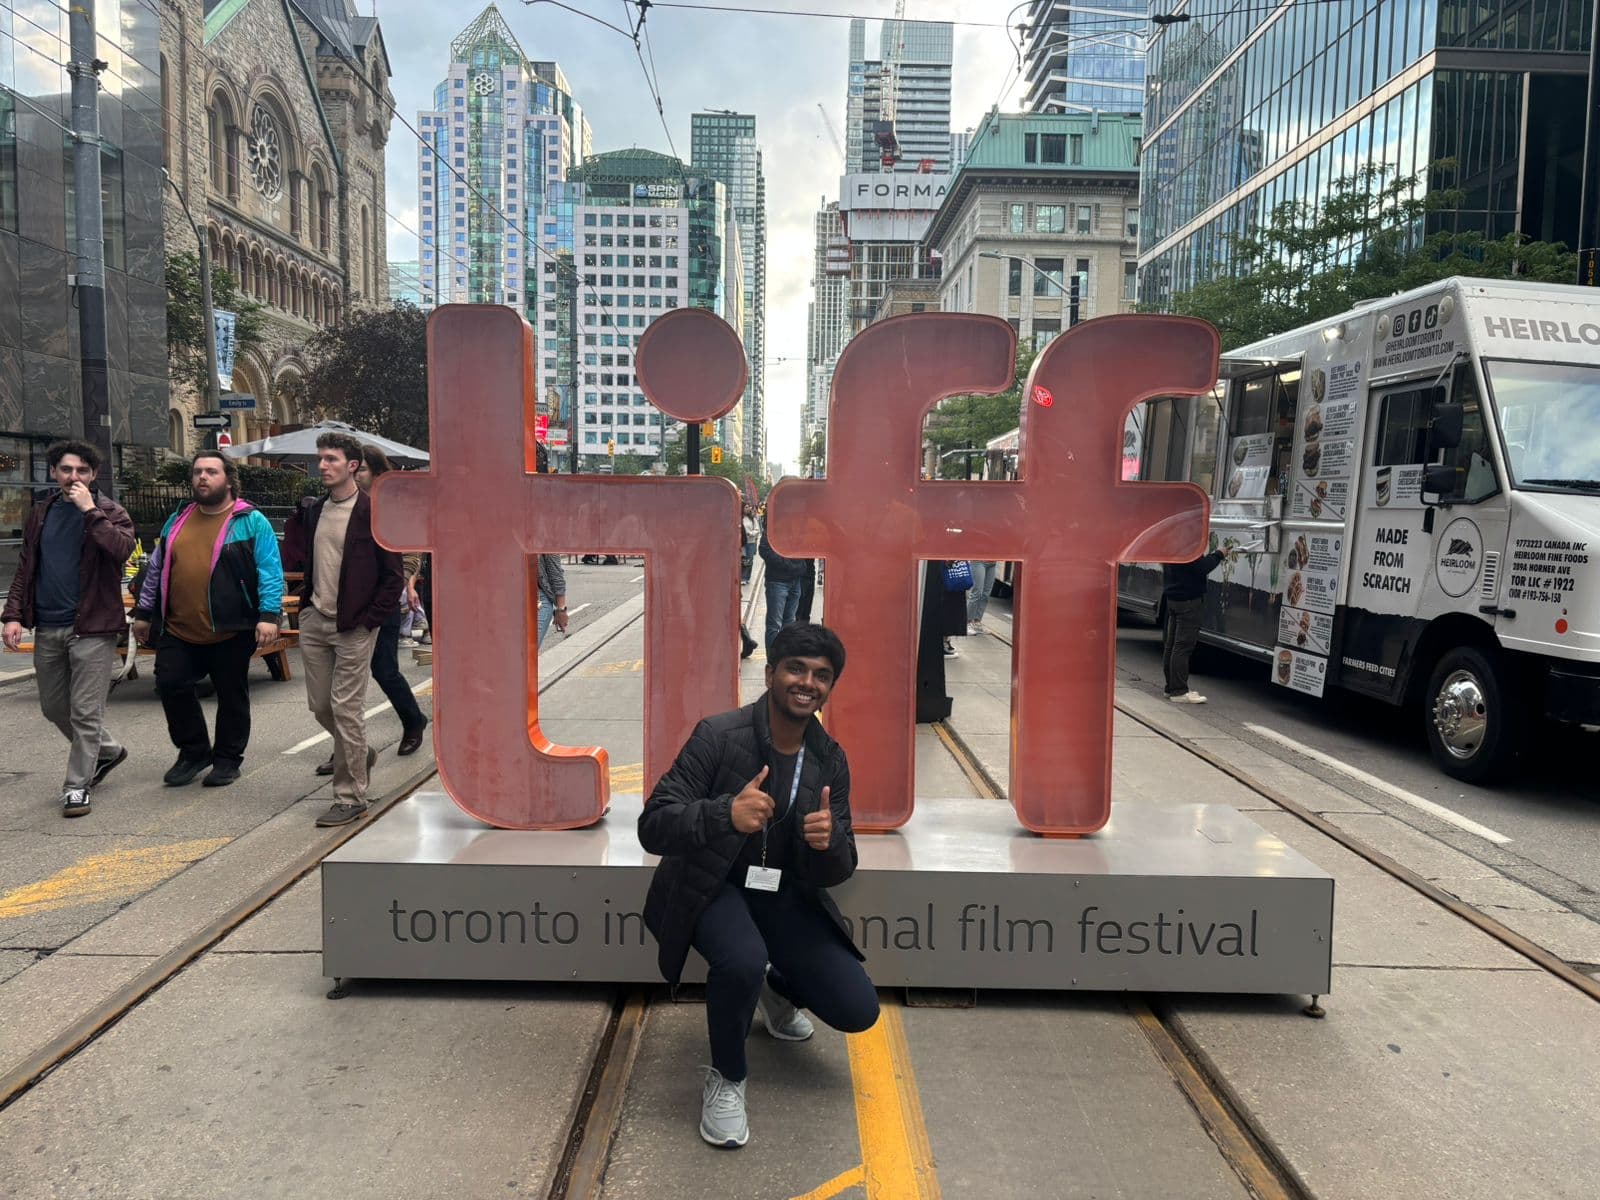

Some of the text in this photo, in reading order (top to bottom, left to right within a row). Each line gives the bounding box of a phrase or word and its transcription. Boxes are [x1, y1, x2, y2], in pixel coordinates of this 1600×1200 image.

[858, 184, 946, 197] FORMA
[1483, 316, 1600, 345] HEIRLO
[1385, 329, 1443, 354] @HEIRLOOMTORONTO
[1373, 340, 1454, 368] WWW.HEIRLOOMTORONTO.COM
[1376, 528, 1408, 544] MADE
[1516, 539, 1587, 551] 9773223 CANADA INC
[1373, 551, 1404, 568] FROM
[1440, 558, 1475, 569] HEIRLOOM
[1514, 550, 1589, 564] HEIRLOOM FINE FOODS
[371, 303, 1221, 836] tiff
[1528, 563, 1556, 574] HORNER
[1557, 565, 1571, 575] AVE
[1363, 572, 1411, 593] SCRATCH
[1511, 575, 1527, 587] TOR
[1528, 576, 1541, 588] LIC
[1553, 577, 1575, 592] 1922
[1342, 656, 1396, 678] FARMERS FEED CITIES
[389, 900, 579, 944] toronto
[958, 904, 1053, 952] film
[1077, 906, 1258, 956] festival
